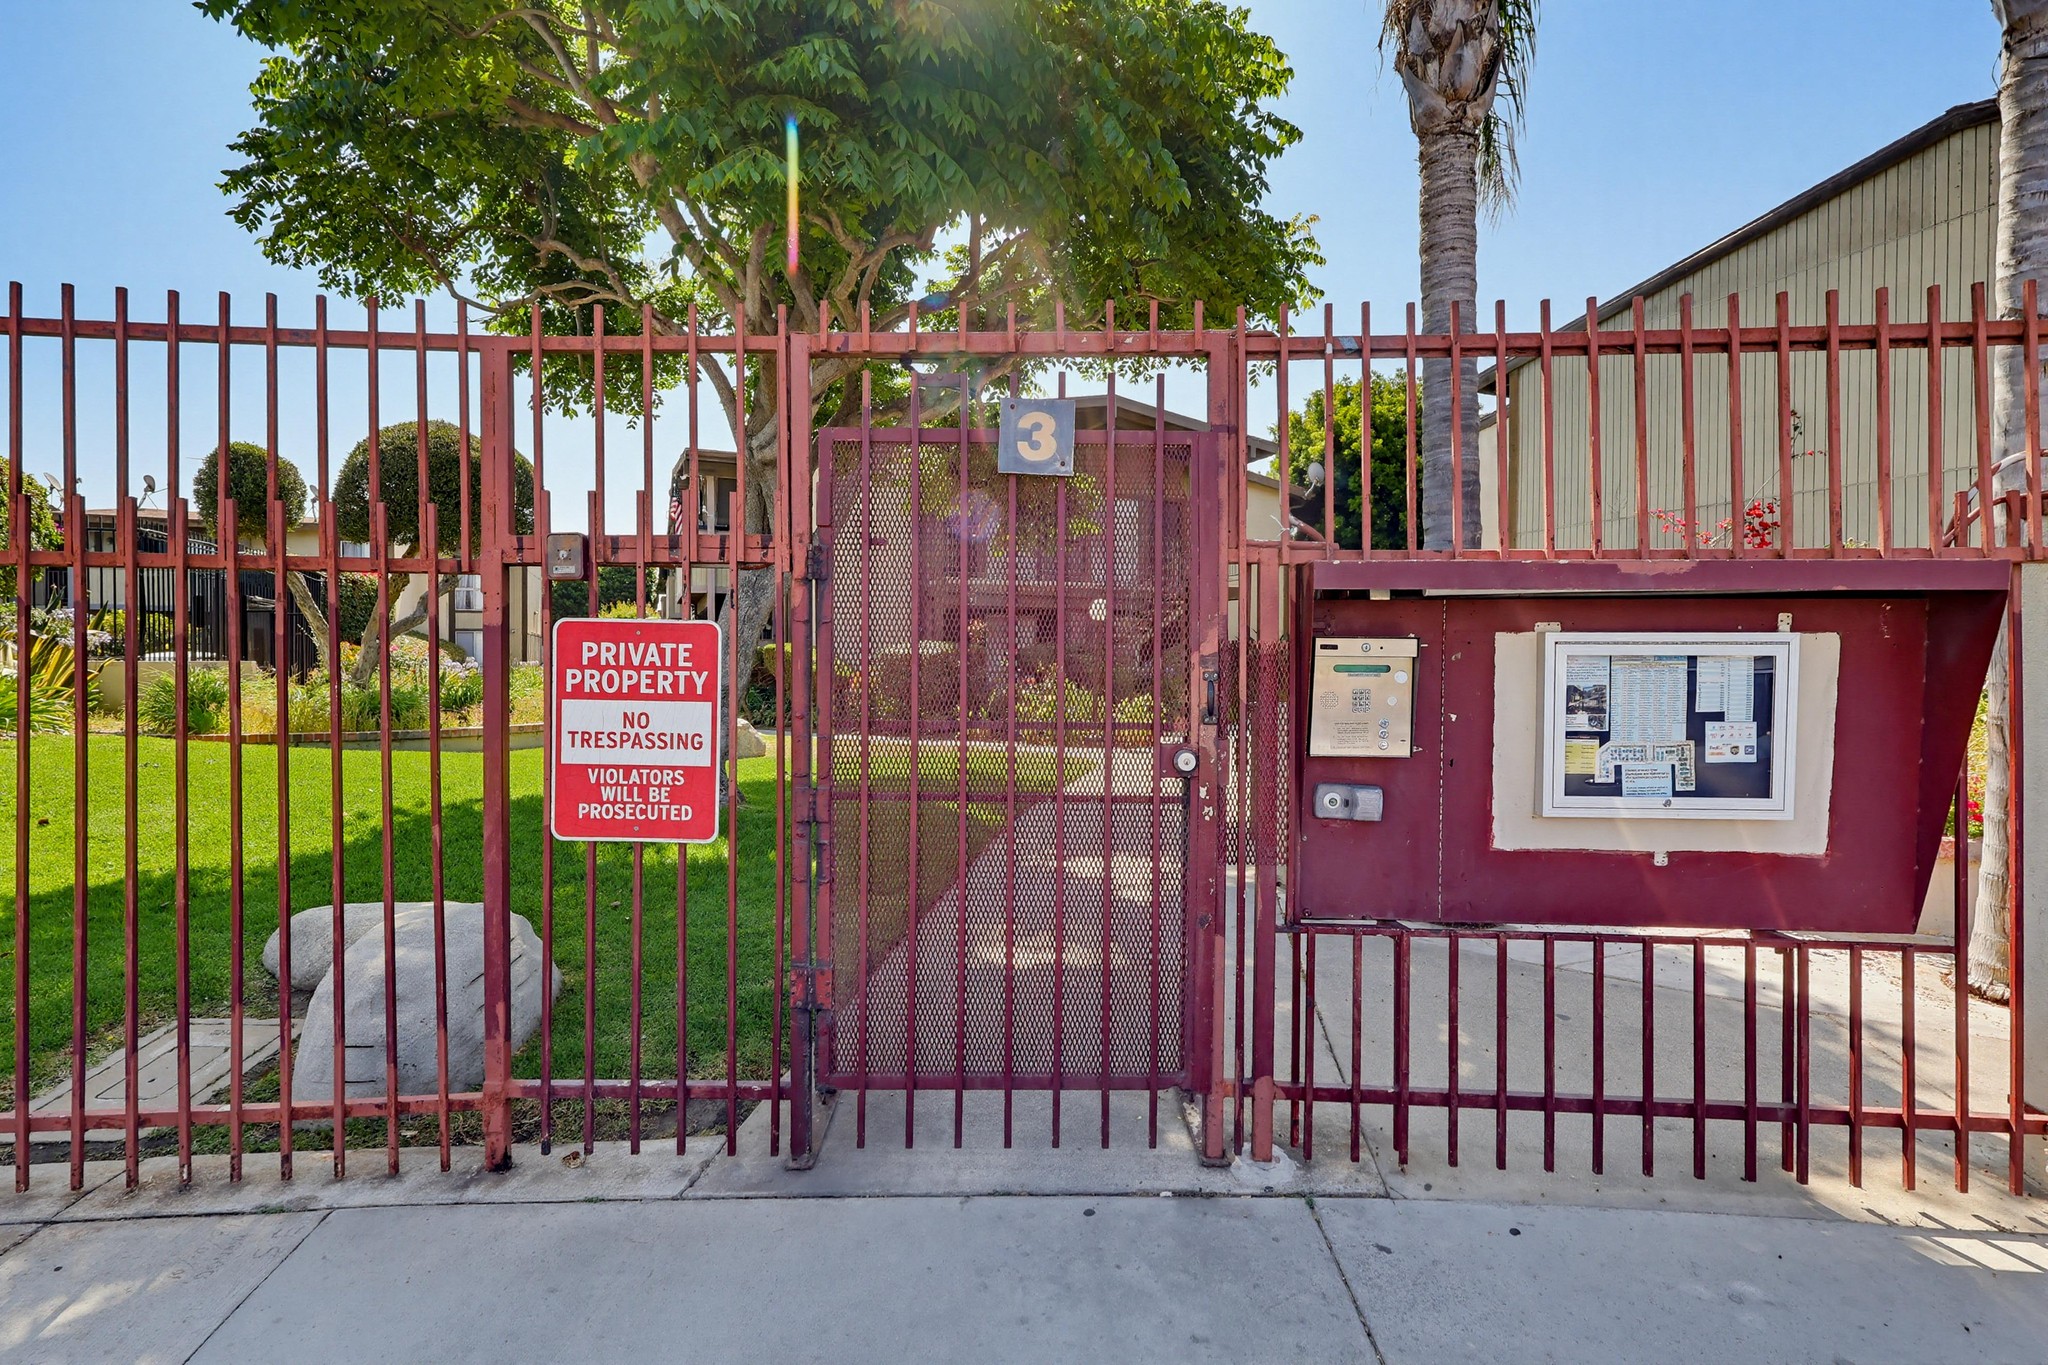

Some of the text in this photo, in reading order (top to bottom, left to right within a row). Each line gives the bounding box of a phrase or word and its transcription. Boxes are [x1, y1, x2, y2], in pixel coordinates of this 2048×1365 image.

[1017, 411, 1058, 461] 3
[581, 642, 693, 667] PRIVATE
[565, 668, 708, 695] PROPERTY
[622, 711, 650, 729] NO
[567, 730, 704, 751] TRESPASSING
[587, 768, 684, 786] VIOLATORS
[600, 786, 671, 803] WILL BE
[578, 803, 693, 821] PROSECUTED
